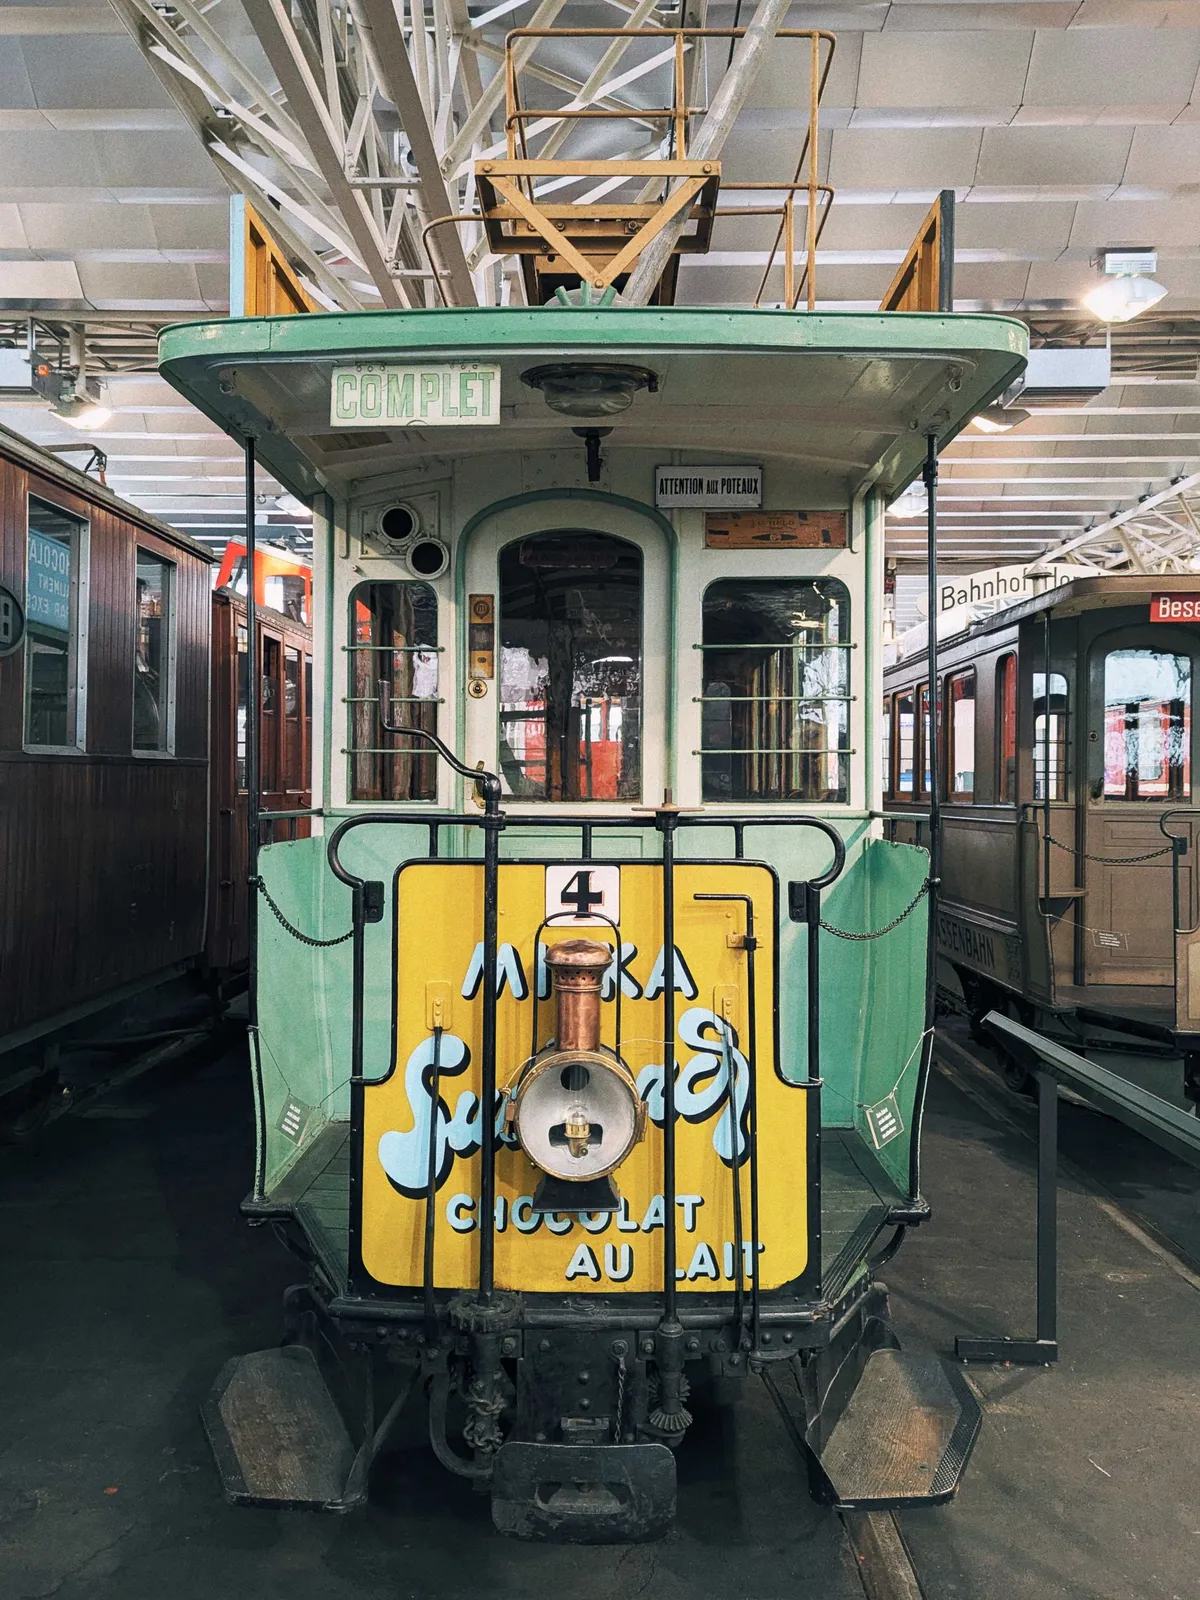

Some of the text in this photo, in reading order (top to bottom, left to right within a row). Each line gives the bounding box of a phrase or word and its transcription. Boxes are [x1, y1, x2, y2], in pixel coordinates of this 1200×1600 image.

[336, 372, 495, 420] COMPLET
[659, 477, 759, 496] ATTENTION AUX POTEAUX
[941, 567, 1028, 611] Bahnhof
[561, 871, 605, 920] 4
[460, 942, 698, 1001] MIKA
[565, 1243, 633, 1281] AU
